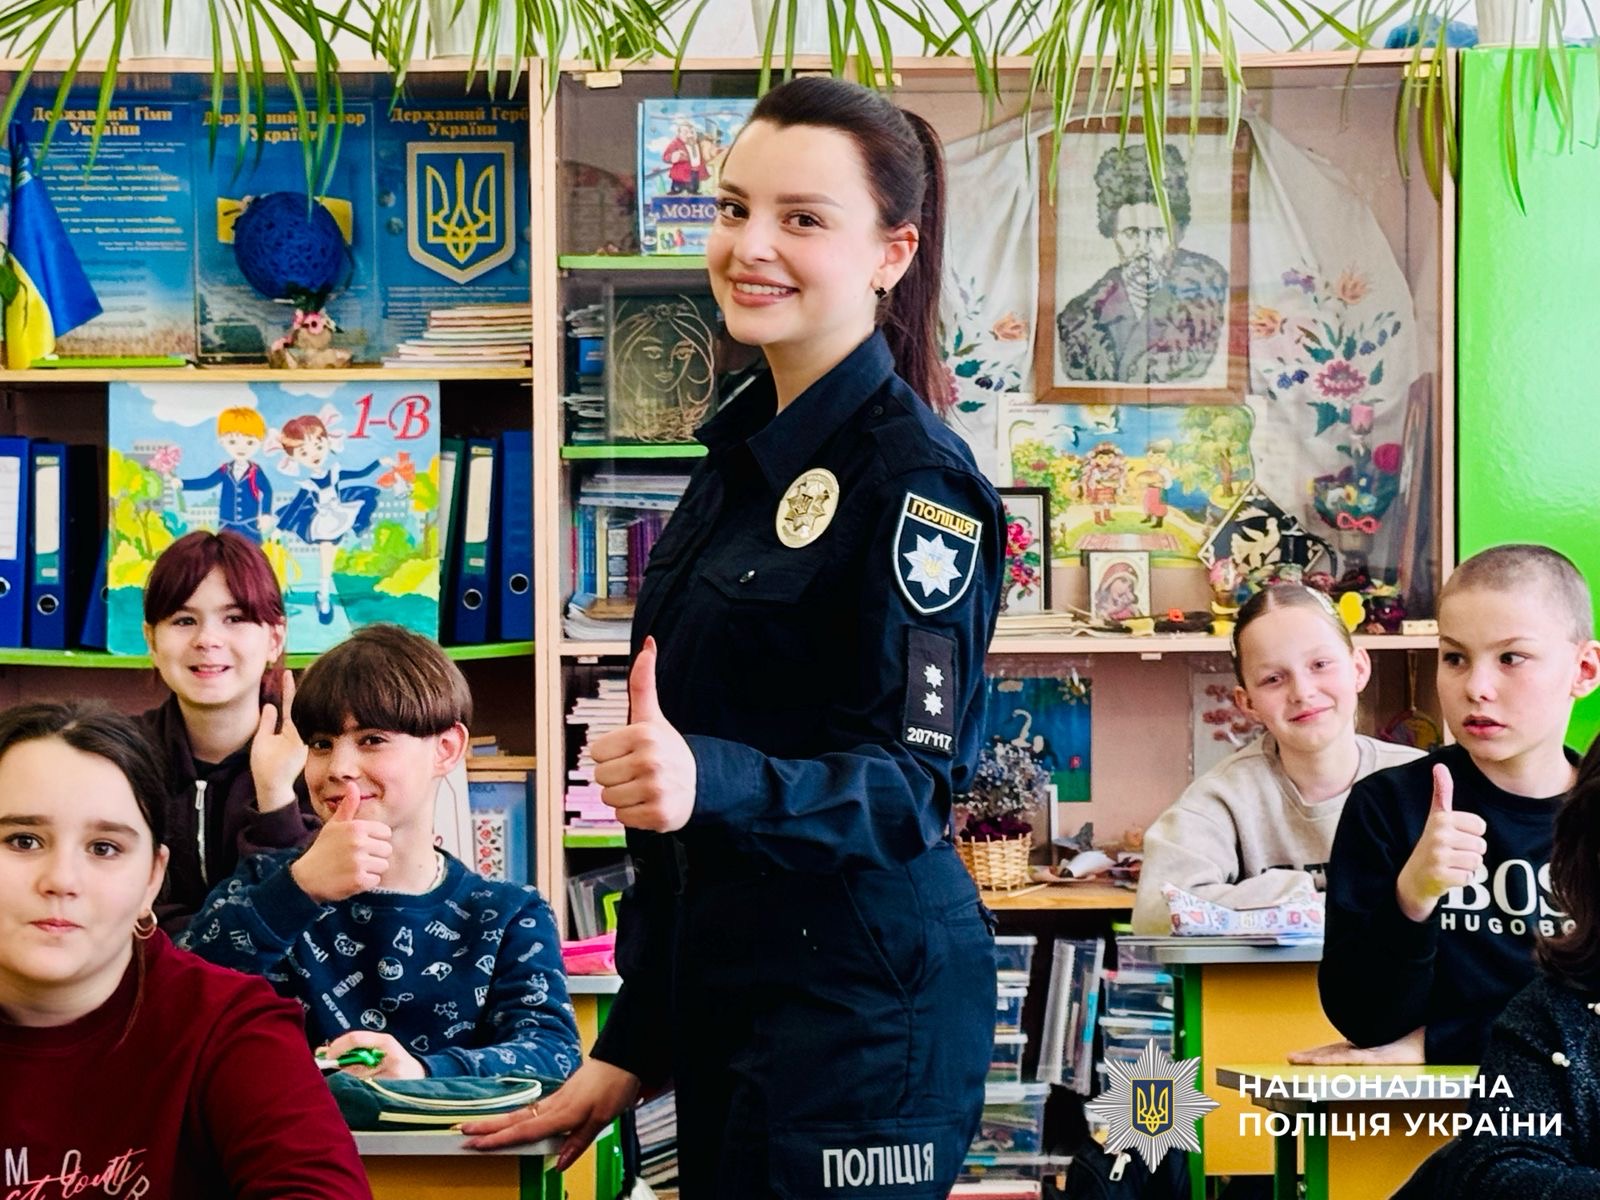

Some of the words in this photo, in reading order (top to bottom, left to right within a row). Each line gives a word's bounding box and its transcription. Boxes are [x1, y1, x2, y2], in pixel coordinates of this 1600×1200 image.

[135, 106, 172, 121] Гімн
[390, 107, 485, 124] Державний
[428, 121, 497, 138] України
[911, 500, 975, 537] ПОЛІЦІЯ
[907, 727, 952, 750] 207117
[1441, 912, 1527, 935] HUGO
[822, 1142, 934, 1187] ПОЛІЦІЯ
